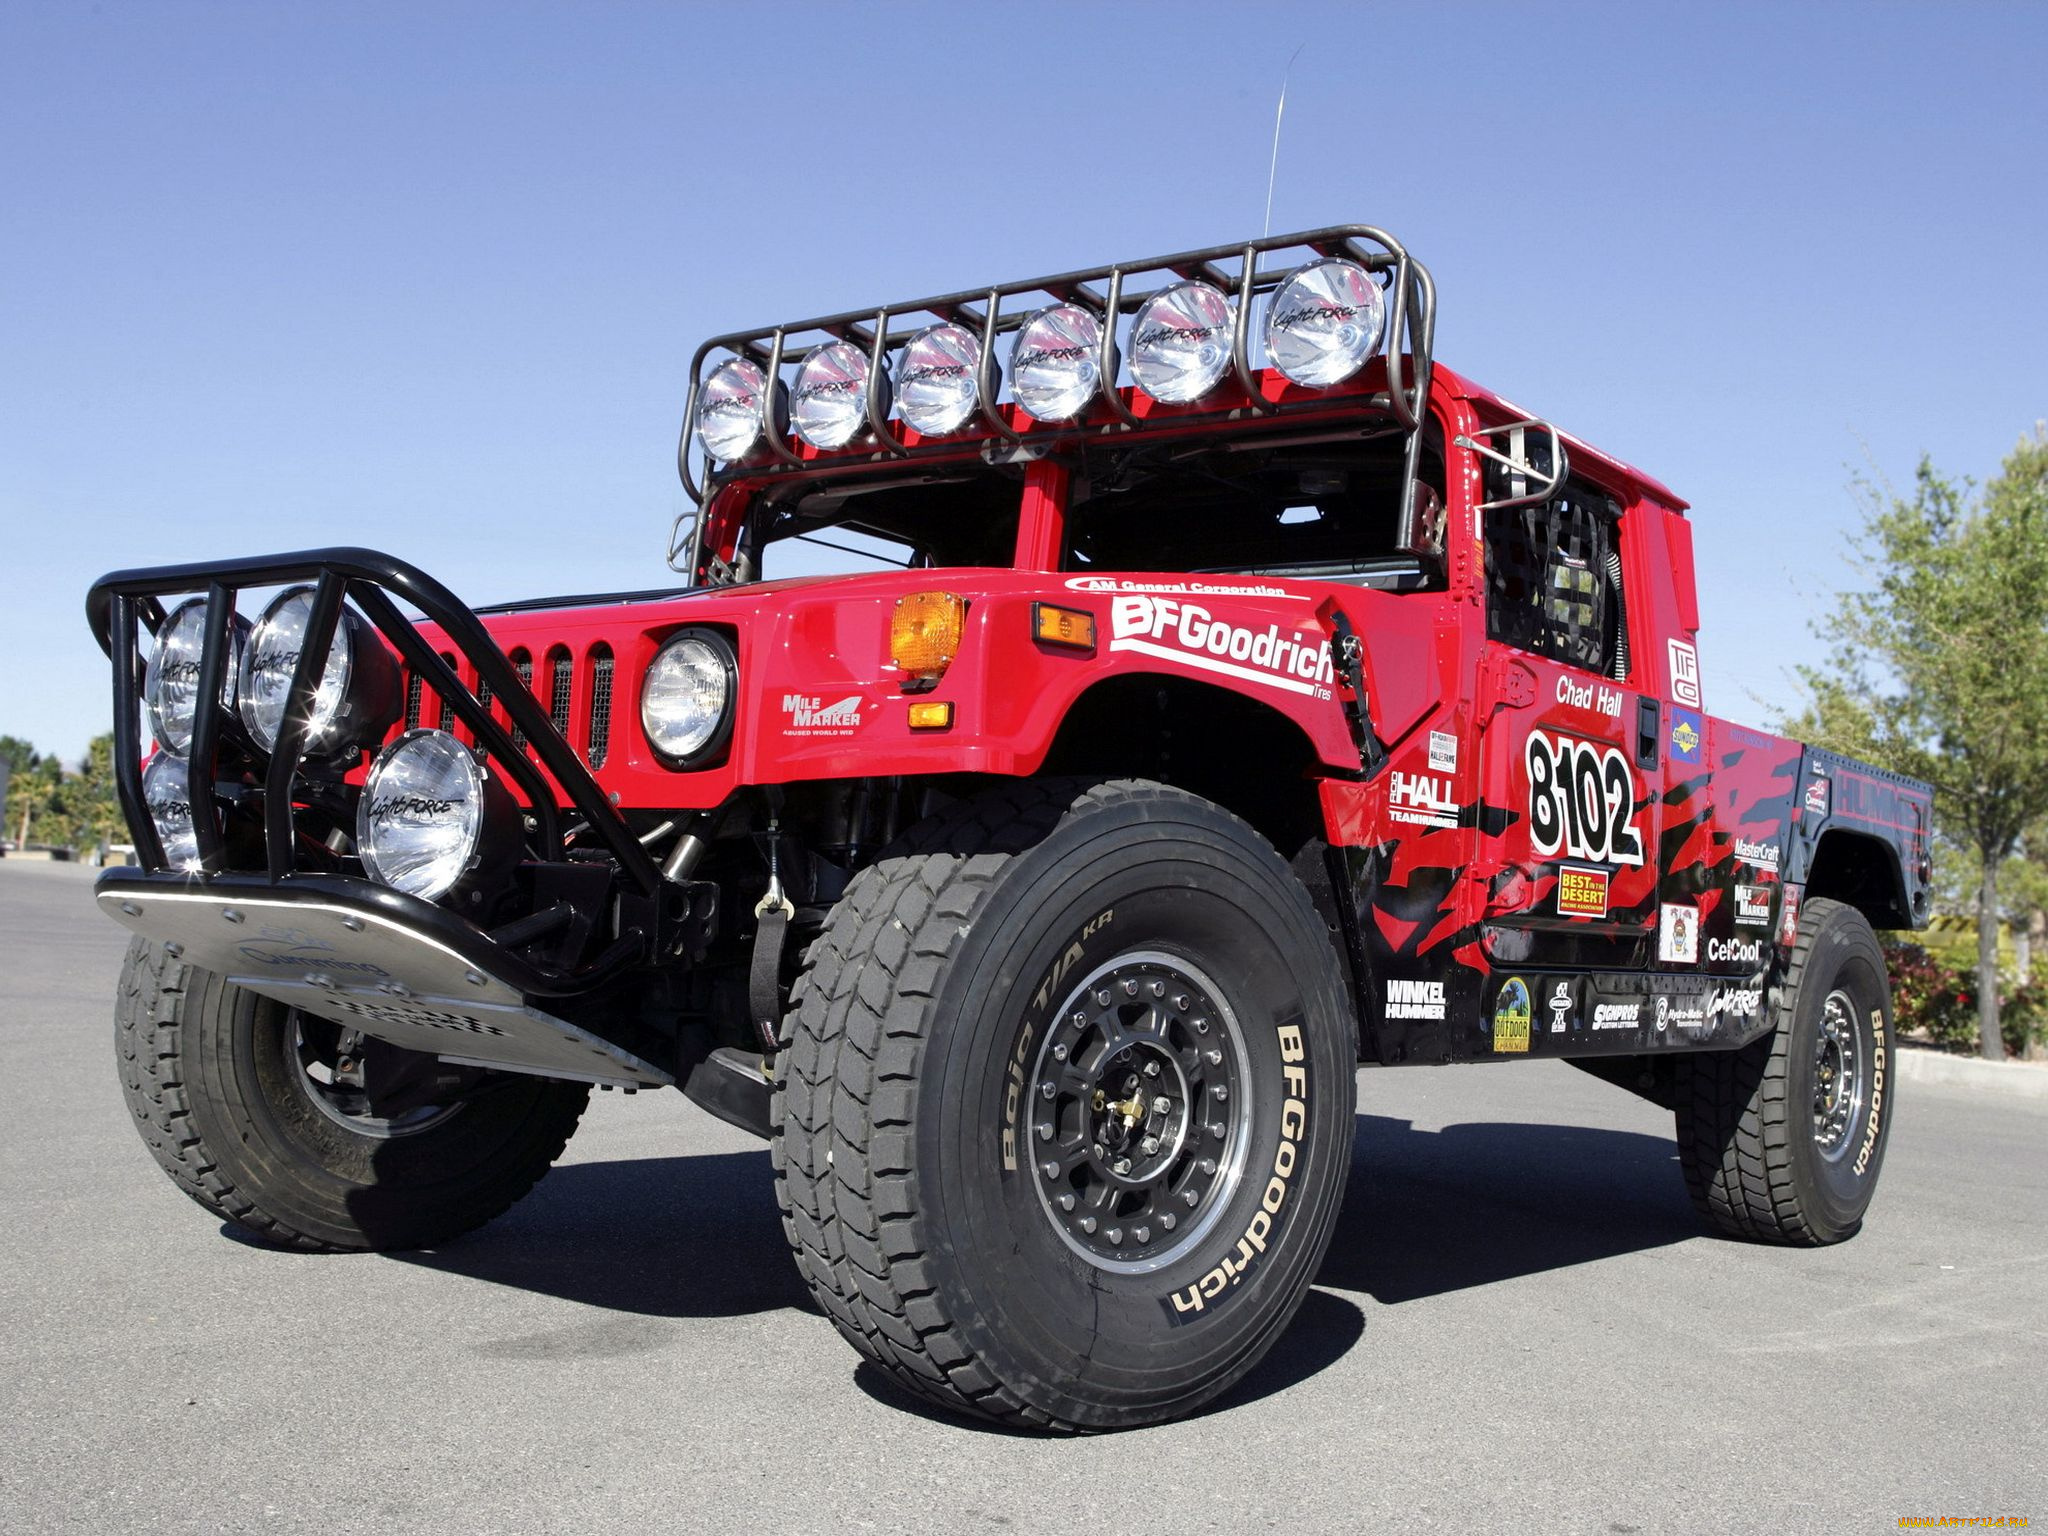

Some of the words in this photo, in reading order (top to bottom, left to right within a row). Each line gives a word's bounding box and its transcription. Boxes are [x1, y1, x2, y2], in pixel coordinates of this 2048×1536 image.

[1088, 580, 1116, 590] AM
[1121, 581, 1185, 593] General
[1191, 583, 1285, 597] Corporation
[1112, 596, 1334, 684] BFGoodrich
[783, 694, 821, 712] MILE
[1556, 675, 1594, 709] Chad
[1597, 686, 1622, 717] Hall
[793, 709, 861, 727] MARKER
[1673, 729, 1699, 746] SUNOCO
[1396, 772, 1459, 812] HALL
[1525, 729, 1644, 866] 8102
[367, 796, 465, 827] LightFORCE
[1735, 838, 1779, 861] MasterCraft
[1562, 873, 1591, 889] BEST
[1561, 887, 1605, 904] DESERT
[1735, 885, 1752, 901] MILE
[1740, 899, 1769, 917] MARKER
[1387, 980, 1446, 1005] WINKEL
[1385, 1003, 1445, 1020] HUMMER
[1495, 1019, 1528, 1038] OUTDOOR
[1003, 1021, 1034, 1170] Baja
[1033, 941, 1085, 1012] T/A
[1083, 909, 1114, 941] KR
[1852, 1009, 1886, 1177] BFGoodrich
[1171, 1024, 1306, 1312] BFGoodrich
